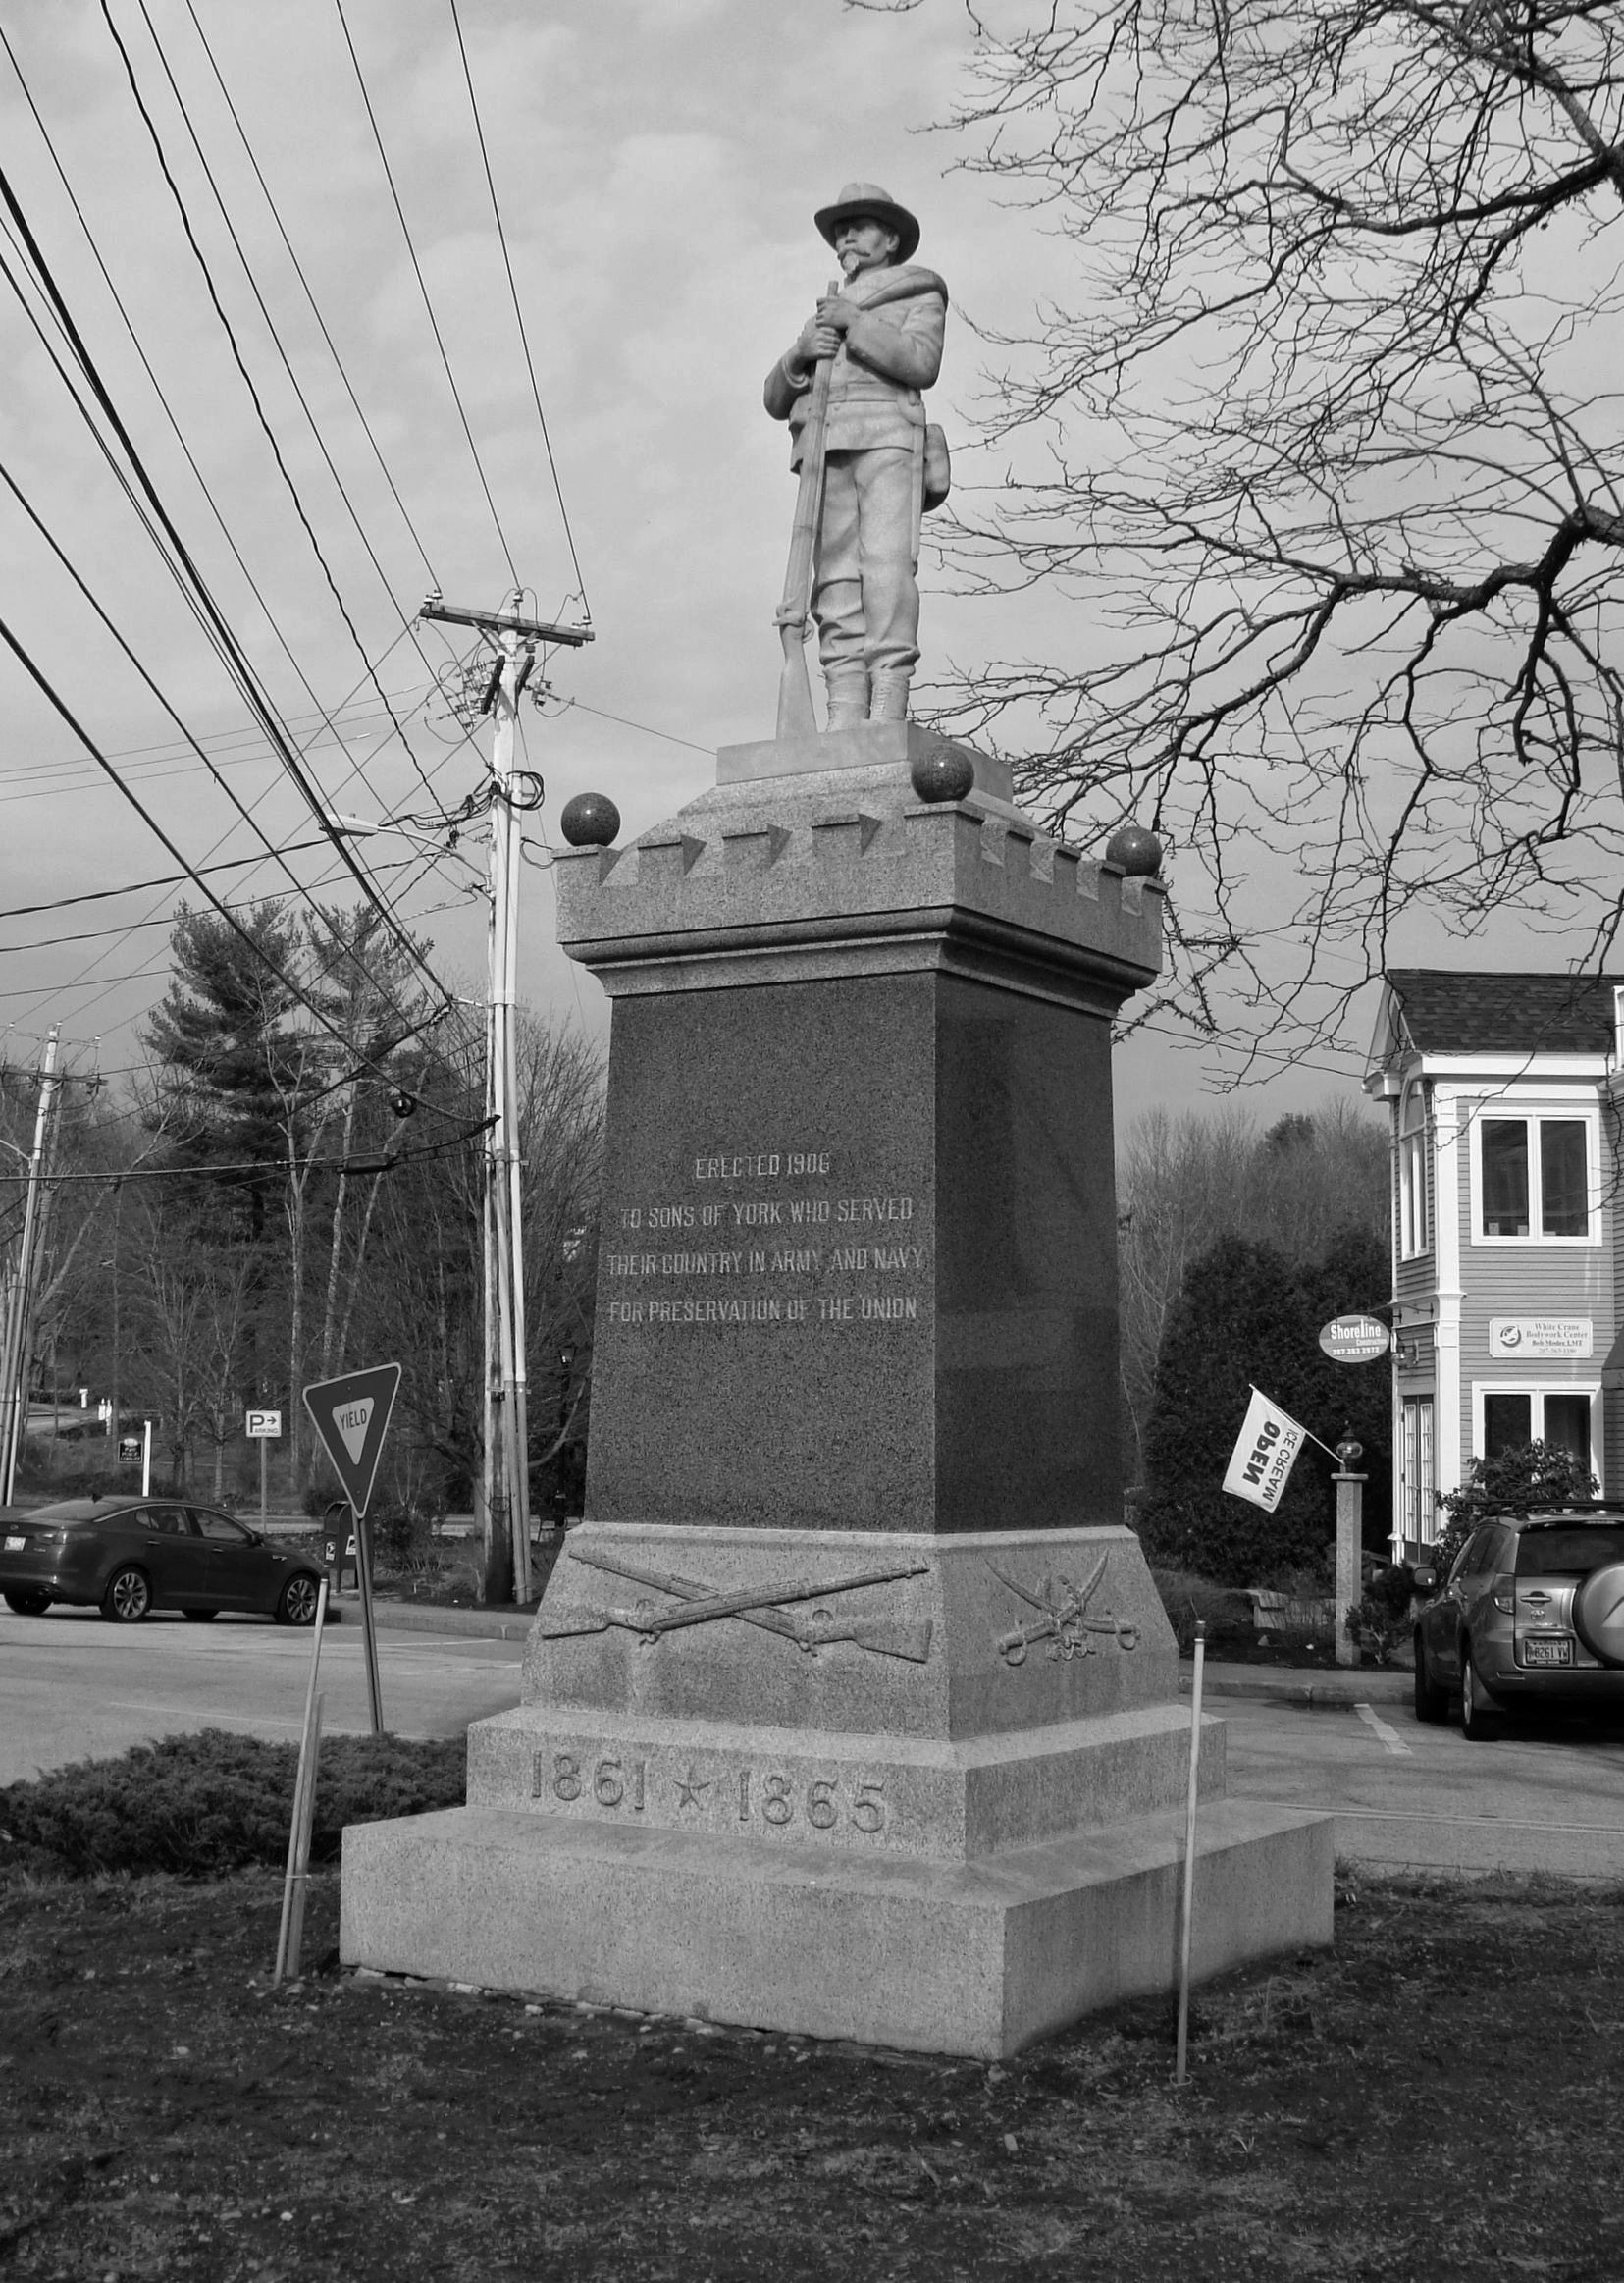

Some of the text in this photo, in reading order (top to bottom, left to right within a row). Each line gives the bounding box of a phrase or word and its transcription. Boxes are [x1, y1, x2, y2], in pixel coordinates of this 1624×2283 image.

[695, 1152, 831, 1179] ERECTED 1906
[620, 1197, 913, 1229] TO SONS OF YORK WHO SERVED
[606, 1247, 925, 1276] THEIR COUNTRY IN ARMY AND NAVY
[608, 1297, 917, 1323] FOR PRESERVATION OF THE UNION
[1330, 1318, 1382, 1340] Shoreline
[340, 1408, 367, 1431] YIELD
[531, 1750, 885, 1834] 1861 1865
